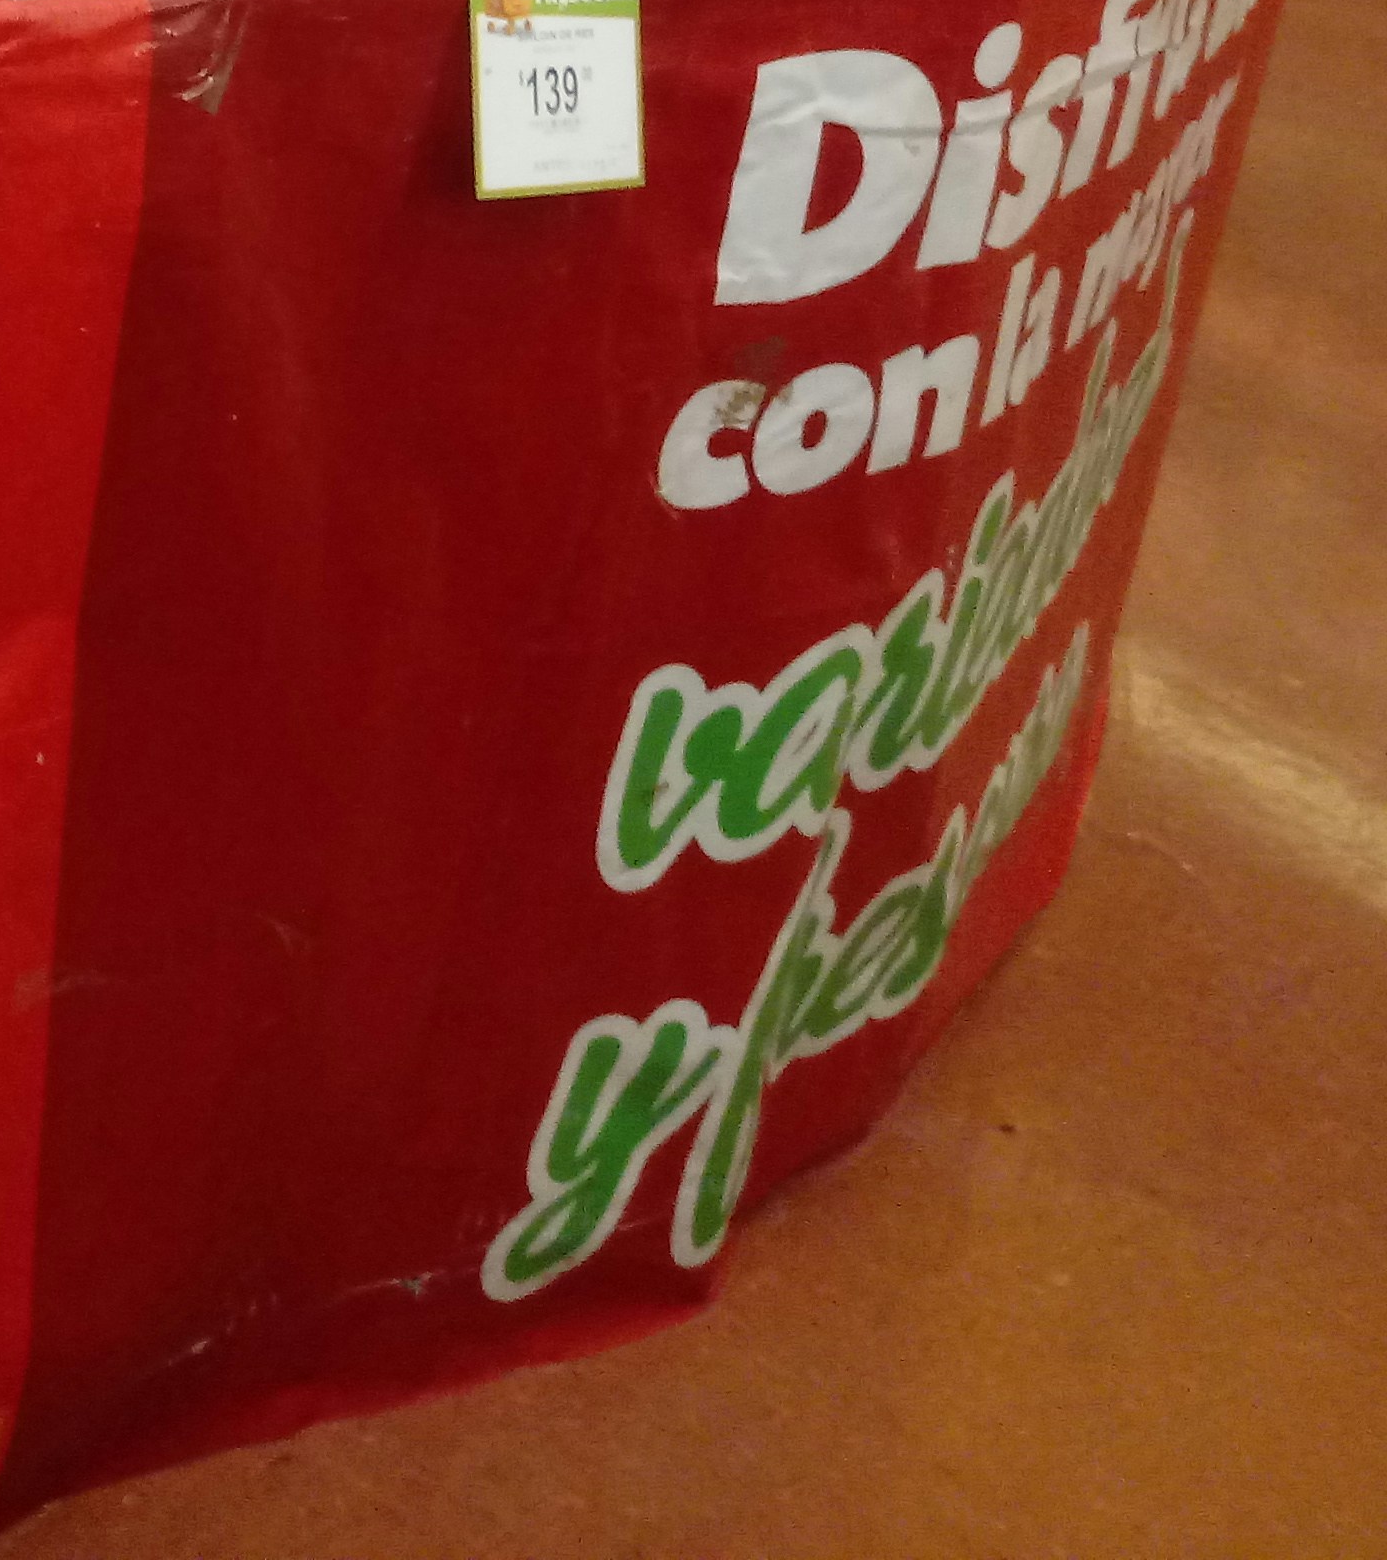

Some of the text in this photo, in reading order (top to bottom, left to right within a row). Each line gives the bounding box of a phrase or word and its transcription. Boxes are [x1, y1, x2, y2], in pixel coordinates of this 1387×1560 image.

[658, 334, 981, 511] con
[980, 250, 1061, 428] la
[481, 996, 742, 1303] y
